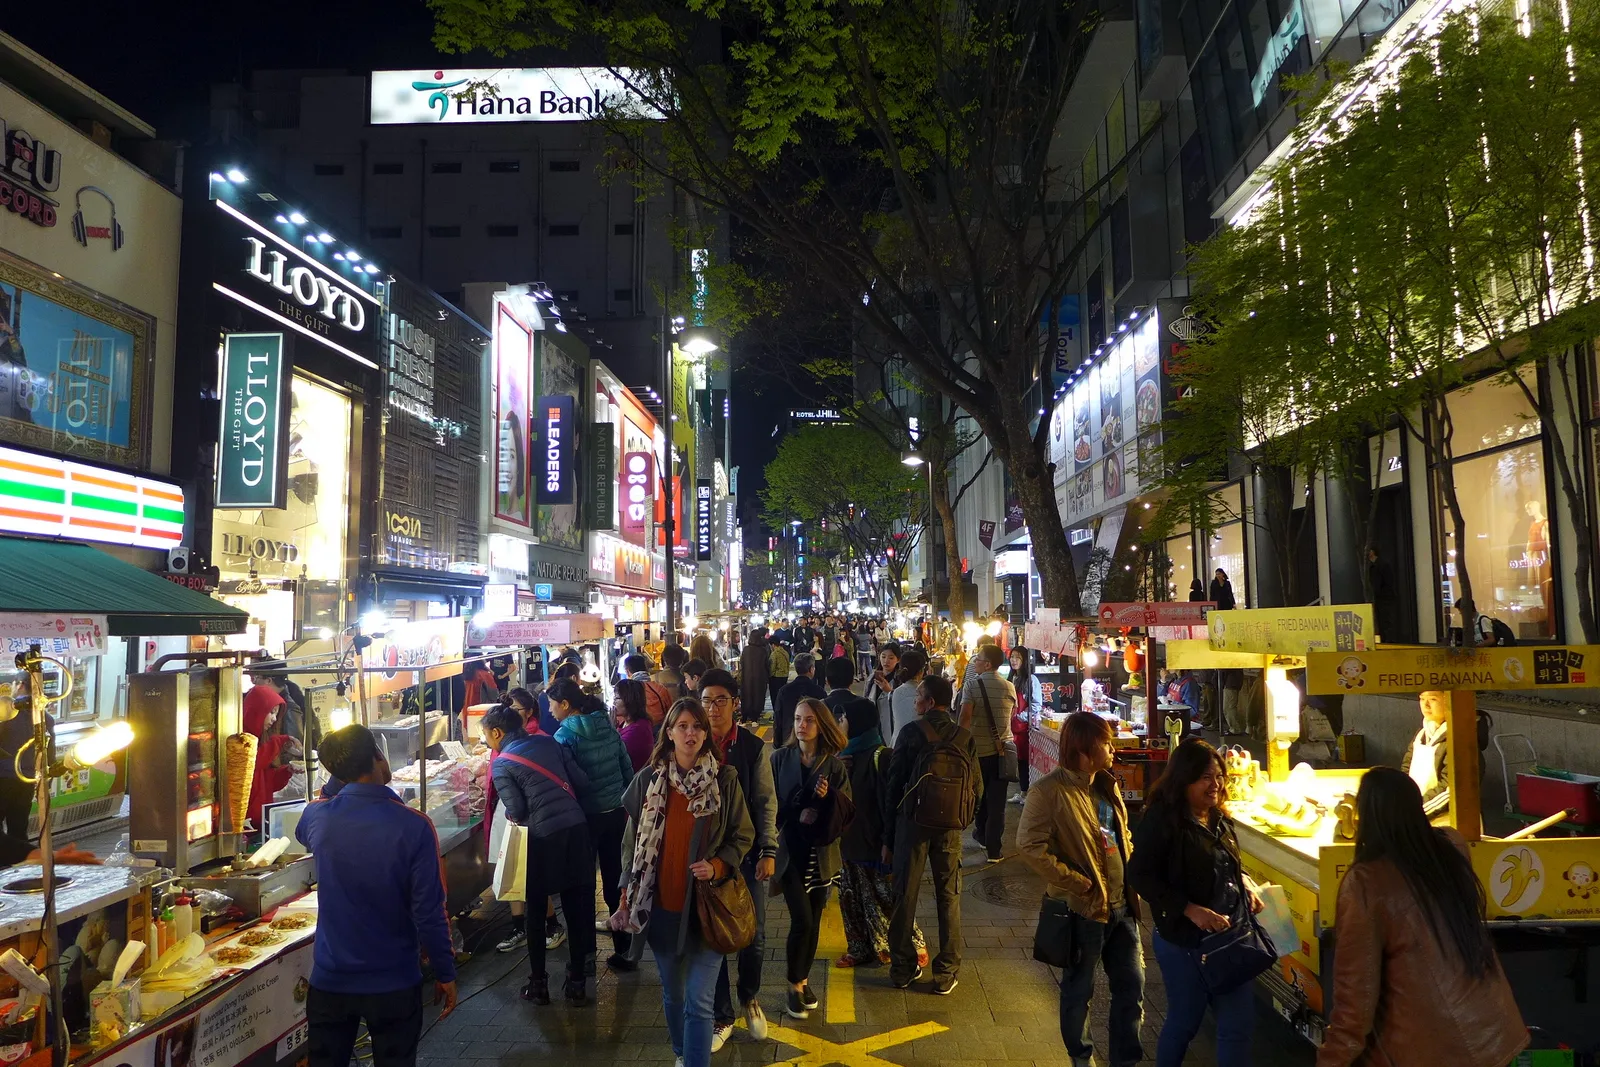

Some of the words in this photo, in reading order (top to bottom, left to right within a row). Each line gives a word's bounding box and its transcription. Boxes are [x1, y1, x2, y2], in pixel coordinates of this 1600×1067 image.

[456, 91, 532, 115] Hana
[539, 88, 608, 115] Bank
[0, 117, 62, 192] 2U
[85, 225, 112, 239] MUSIC
[241, 236, 366, 332] LLOYD
[278, 299, 302, 321] THE
[304, 313, 331, 335] GIFT
[390, 313, 436, 363] LUSH
[389, 344, 435, 388] FRESH
[234, 388, 243, 416] THE
[389, 371, 434, 405] HANDMADE
[232, 419, 242, 451] GIFT
[242, 353, 269, 487] LLOYD
[547, 418, 560, 492] LEADERS
[597, 427, 609, 471] NATURE
[596, 473, 607, 526] REPUBLIC
[699, 500, 709, 552] MISSHA
[726, 502, 735, 538] innisfree
[981, 523, 993, 533] 4F
[222, 532, 299, 562] LLOYD
[188, 576, 206, 590] BOX
[536, 561, 561, 579] NATURE
[562, 565, 589, 583] REPUBLIC
[74, 630, 94, 648] 1+1
[1277, 618, 1298, 631] FRIED
[1299, 618, 1330, 631] BANANA
[53, 637, 70, 653] 돌파
[1336, 633, 1352, 650] 튀김
[1538, 652, 1581, 667] 바나나
[1378, 674, 1425, 687] FRIED
[1429, 672, 1495, 687] BANANA
[1539, 668, 1562, 682] 튀김
[257, 983, 266, 993] Ice
[202, 1052, 215, 1067] 명동
[216, 1044, 229, 1057] 터키
[229, 1028, 256, 1049] 아이스크림
